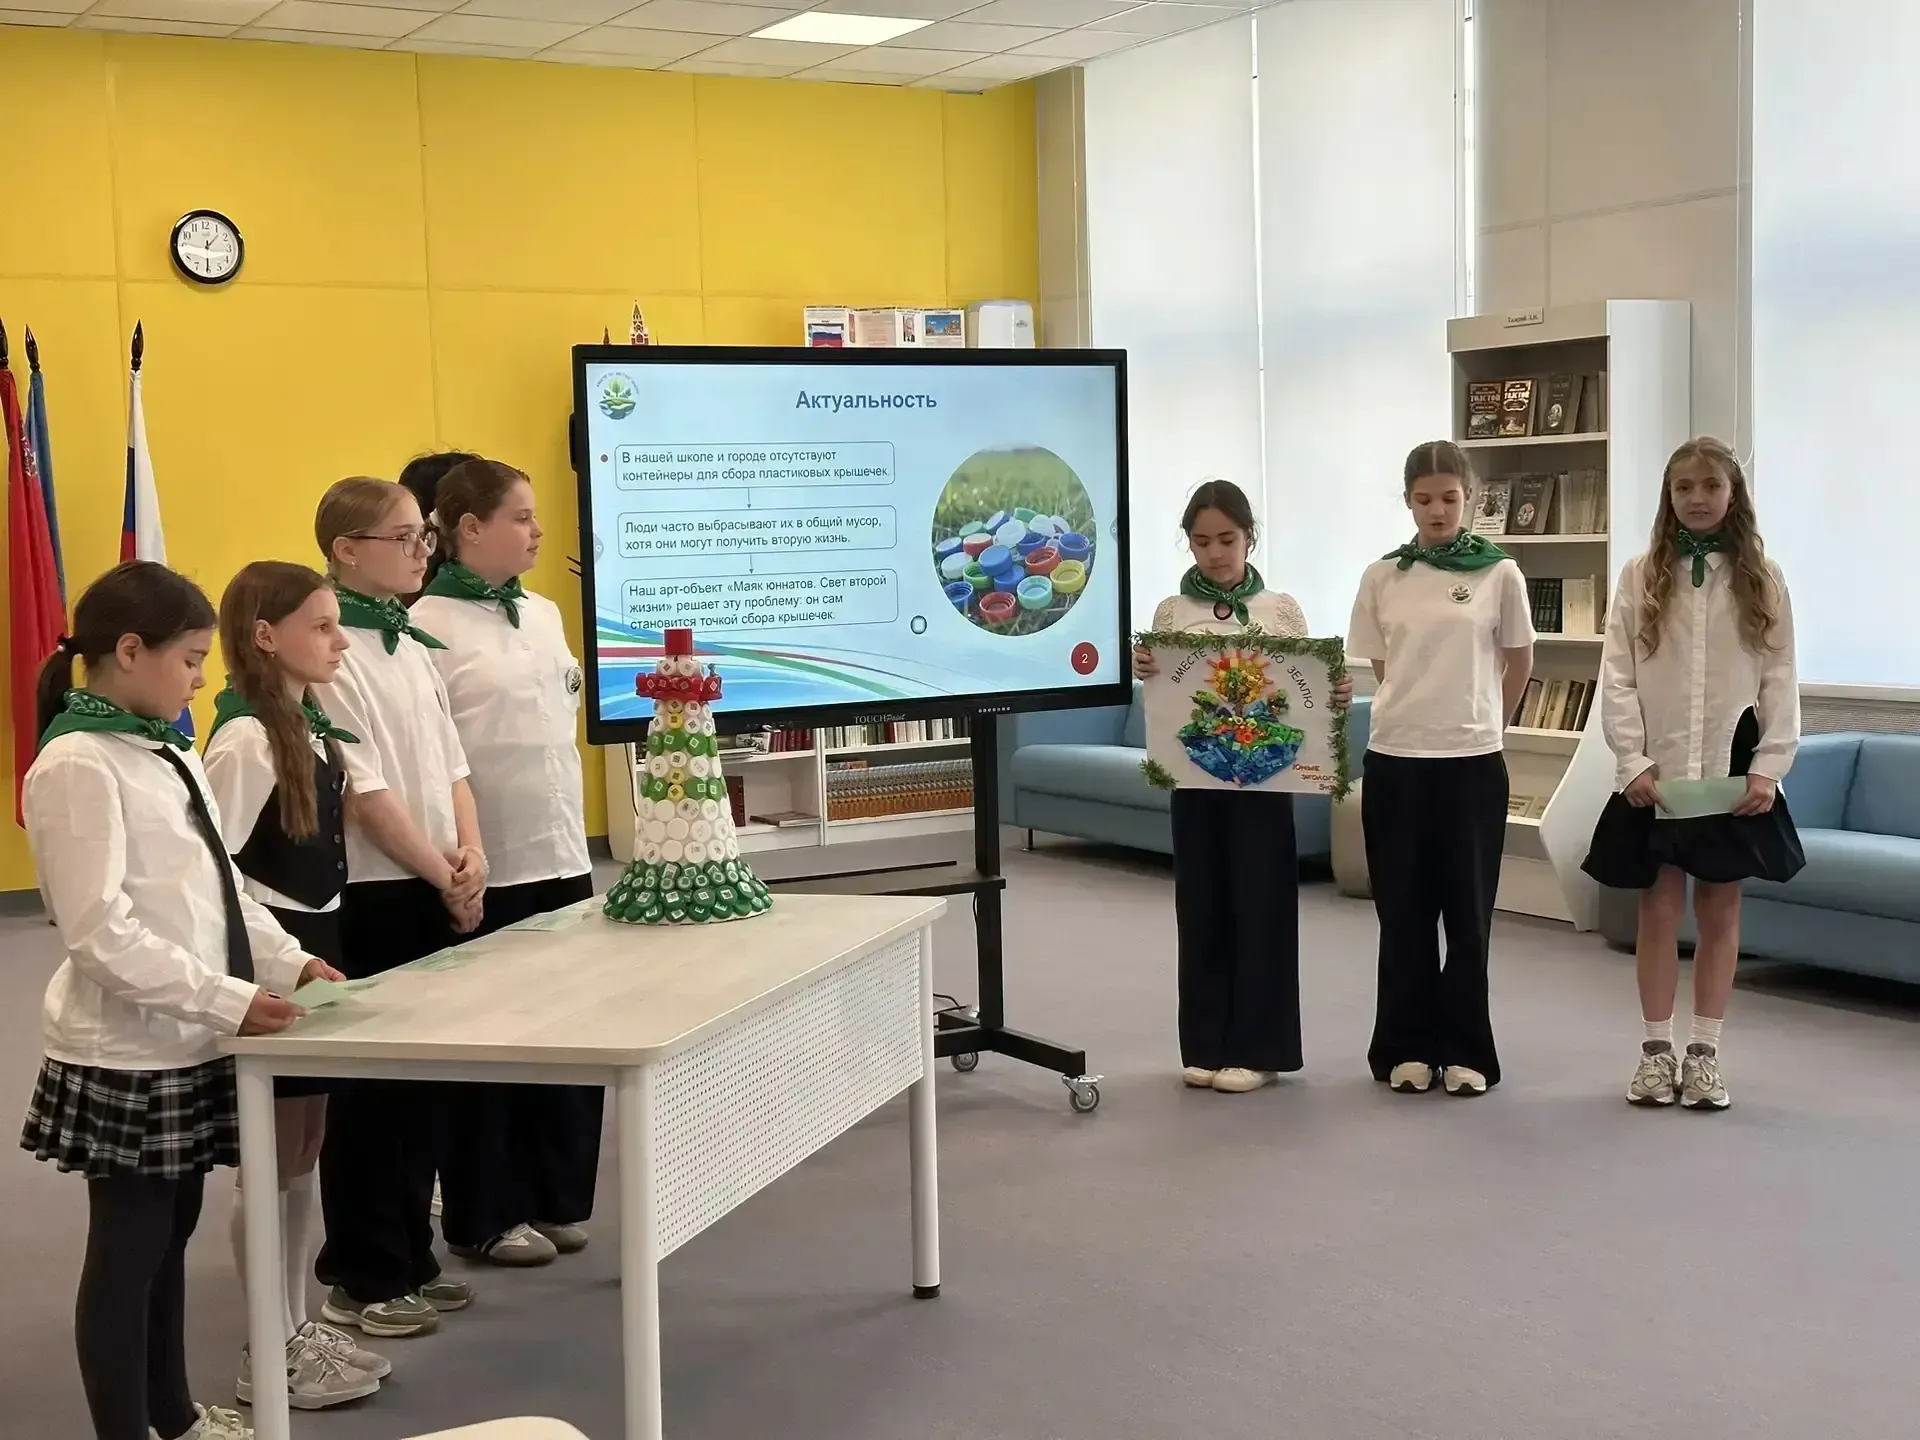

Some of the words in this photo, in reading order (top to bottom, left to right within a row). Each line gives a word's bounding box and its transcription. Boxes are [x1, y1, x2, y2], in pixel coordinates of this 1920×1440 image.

[191, 223, 198, 232] 11
[201, 221, 210, 230] 12
[215, 224, 218, 233] 1
[183, 231, 191, 240] 10
[222, 233, 228, 242] 2
[226, 244, 232, 253] 3
[194, 261, 199, 271] 7
[216, 262, 222, 272] 5
[796, 390, 937, 413] Актуальность
[622, 452, 631, 463] В
[634, 452, 673, 463] нашей
[677, 453, 713, 463] школе
[717, 453, 724, 462] и
[727, 452, 766, 464] городе
[769, 451, 837, 463] отсутствуют
[622, 469, 693, 482] контейнеры
[696, 470, 718, 481] для
[721, 467, 756, 481] сбора
[759, 468, 830, 479] пластиковых
[833, 467, 890, 479] крышечек.
[625, 521, 658, 534] Люди
[661, 522, 694, 532] часто
[697, 518, 777, 532] выбрасывают
[780, 519, 794, 529] их
[796, 519, 803, 528] в
[806, 516, 843, 529] общий
[846, 516, 882, 529] мусор,
[625, 540, 652, 550] хотя
[655, 539, 677, 549] они
[680, 538, 713, 550] могут
[716, 536, 768, 549] получить
[771, 535, 812, 547] вторую
[814, 533, 850, 544] жизнь.
[629, 585, 656, 596] Наш
[659, 583, 723, 597] арт-объект
[727, 581, 763, 592] «Маяк
[766, 579, 817, 591] юннатов.
[820, 576, 847, 588] Свет
[849, 575, 887, 588] второй
[629, 603, 672, 613] жизни»
[676, 600, 720, 614] решает
[723, 599, 741, 610] эту
[744, 595, 802, 609] проблему:
[805, 595, 819, 605] он
[822, 594, 843, 604] сам
[630, 618, 697, 630] становится
[700, 614, 738, 627] точкой
[741, 611, 775, 625] сбора
[778, 610, 836, 623] крышечек.
[1081, 653, 1089, 664] 2
[1171, 647, 1208, 684] ВМЕСТЕ
[1286, 665, 1314, 709] ЗЕМЛЮ
